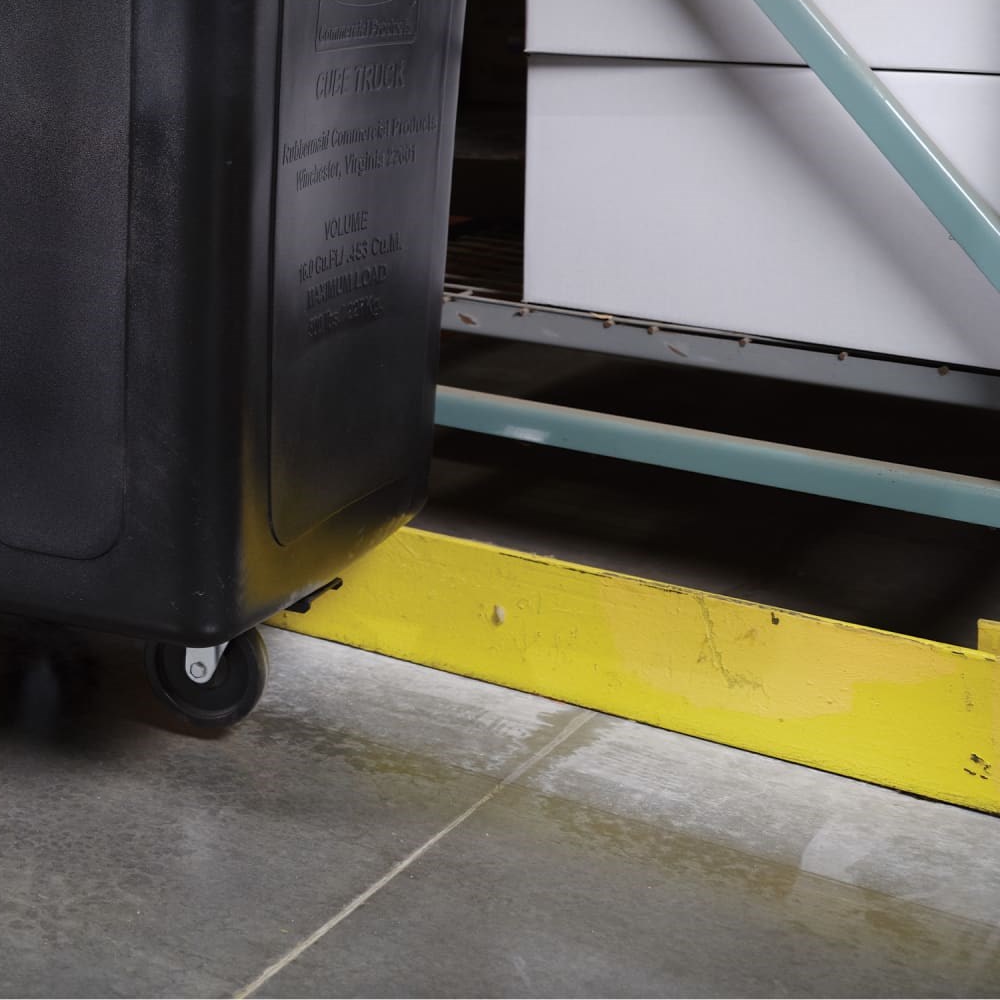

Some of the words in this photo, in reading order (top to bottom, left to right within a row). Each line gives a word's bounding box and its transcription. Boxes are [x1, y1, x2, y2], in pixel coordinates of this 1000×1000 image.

[315, 66, 350, 101] CUBE
[353, 57, 409, 95] TRUCK
[282, 130, 329, 166] Rubbermaid
[331, 120, 389, 148] Commercial
[391, 112, 438, 136] Products
[295, 159, 342, 192] Winchester,
[344, 148, 384, 176] Virginia
[324, 210, 369, 240] VOLUME
[353, 264, 388, 289] LOAD
